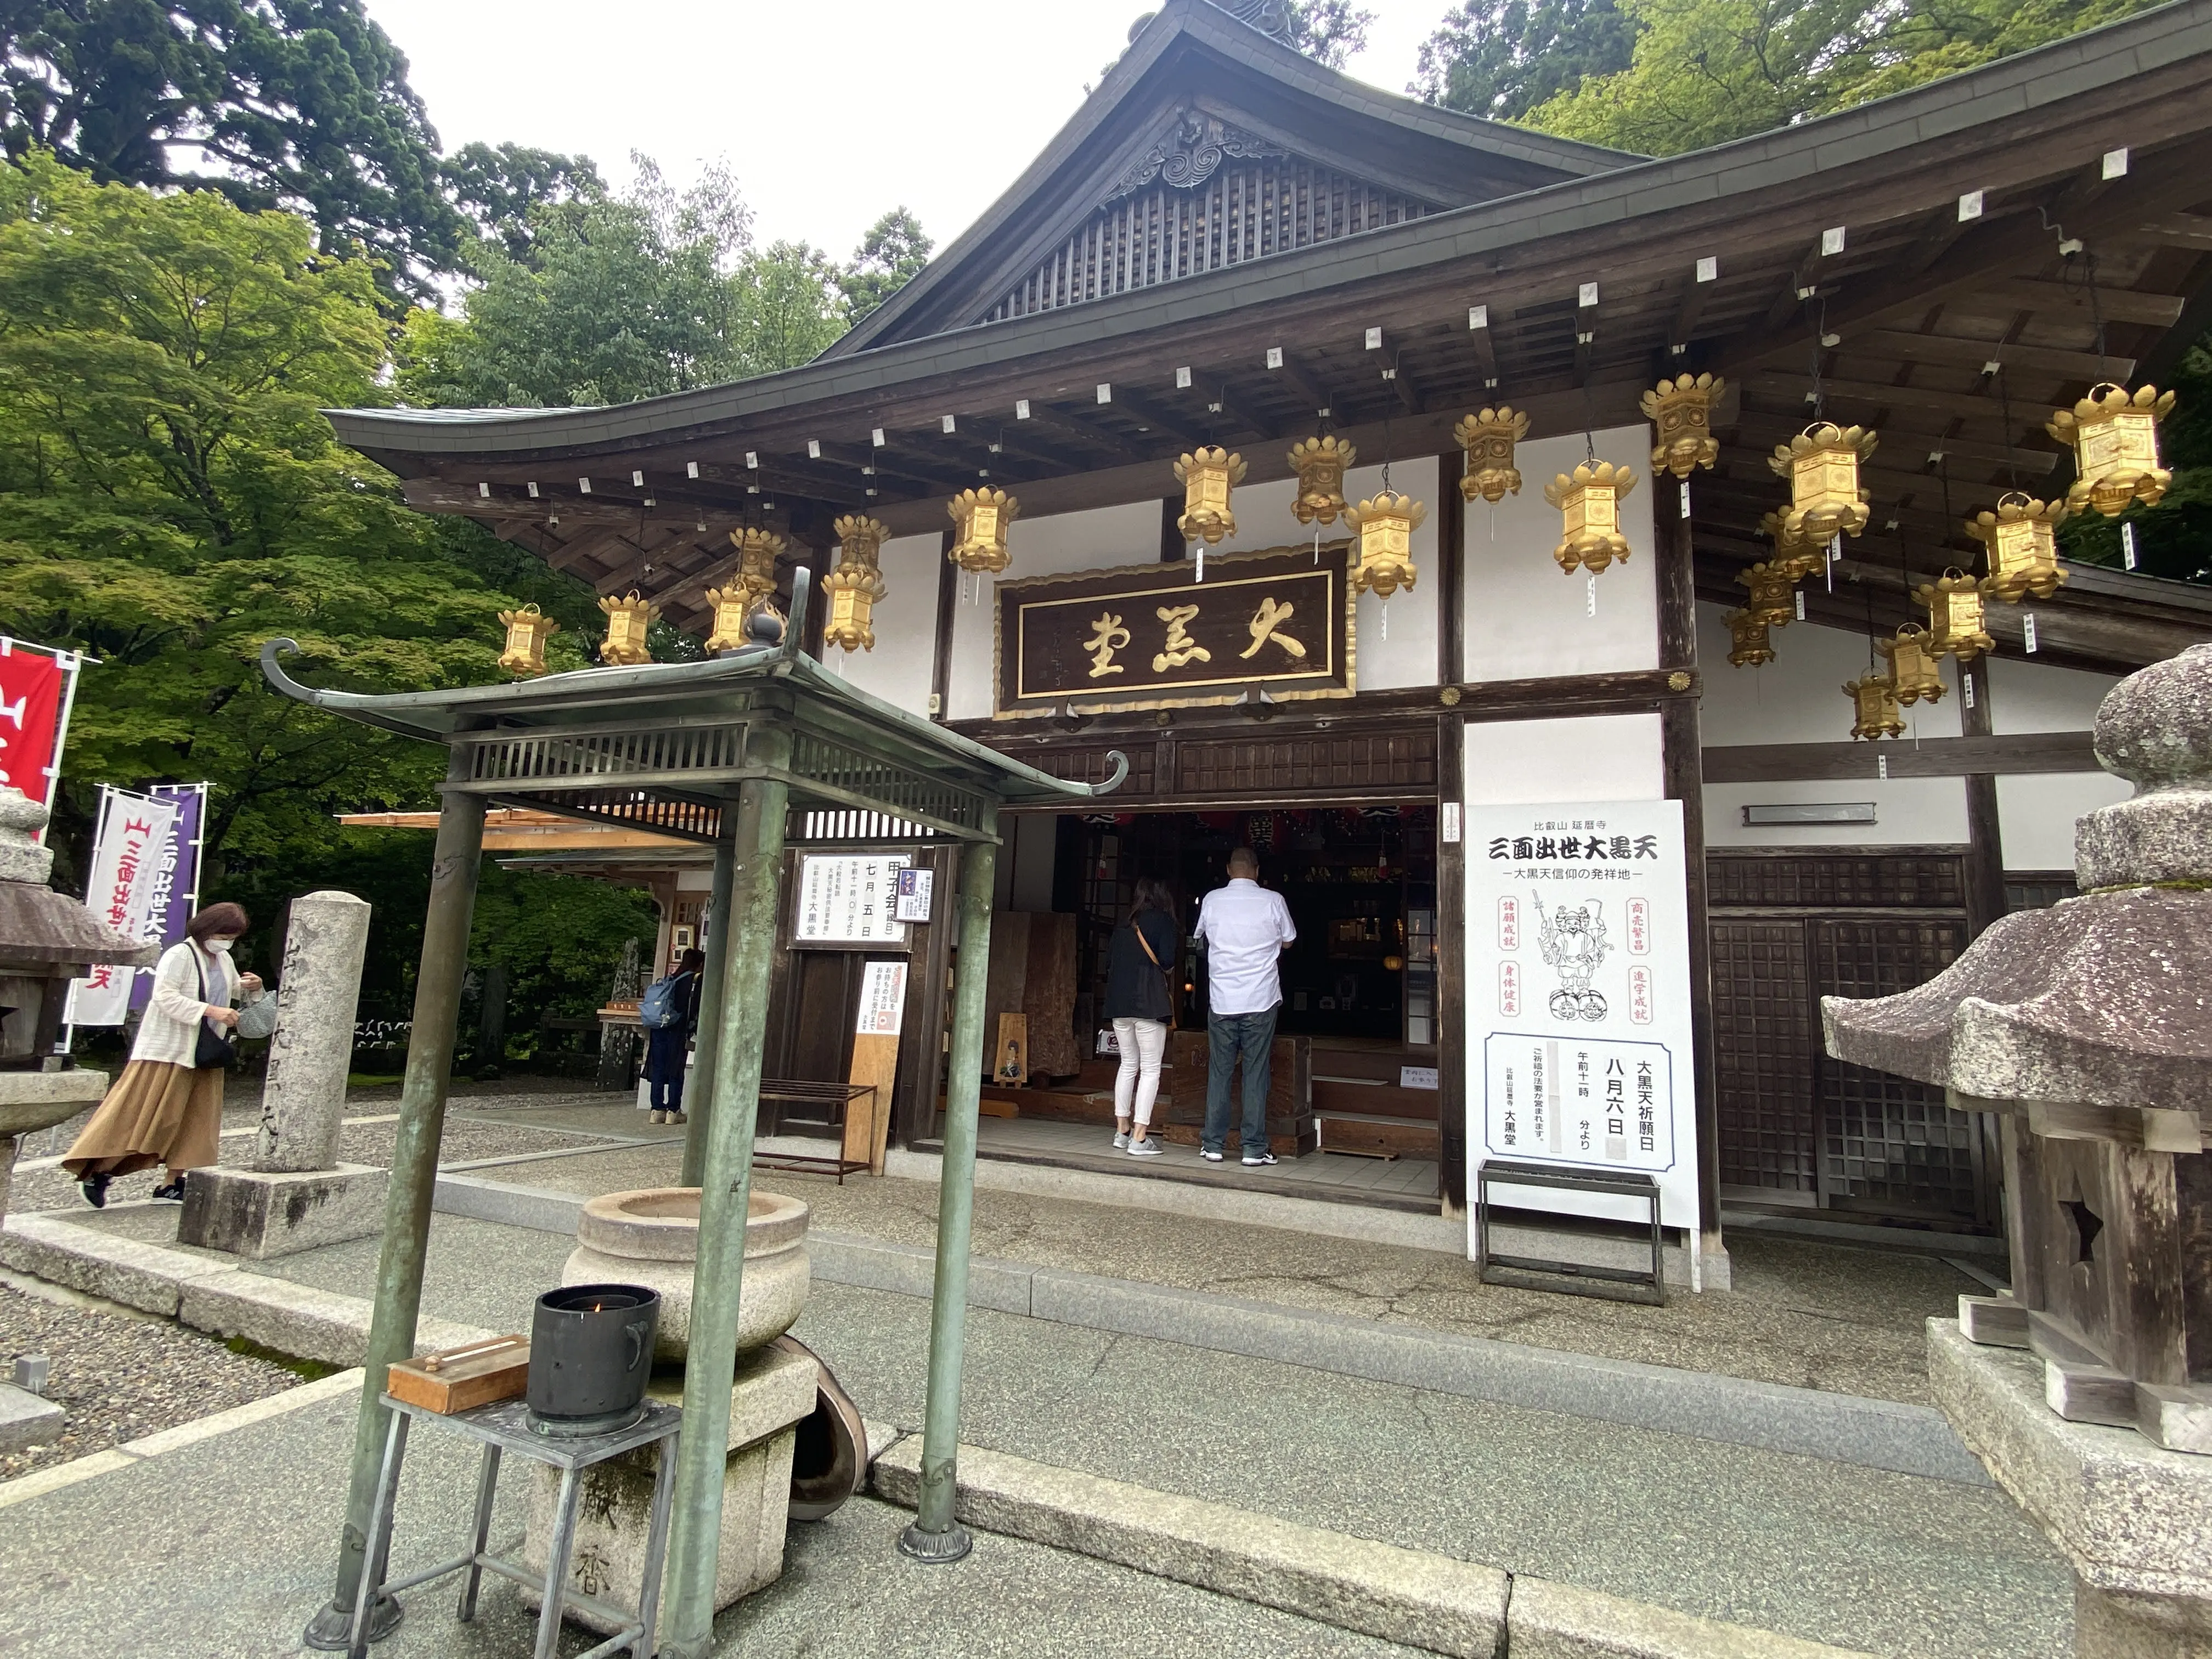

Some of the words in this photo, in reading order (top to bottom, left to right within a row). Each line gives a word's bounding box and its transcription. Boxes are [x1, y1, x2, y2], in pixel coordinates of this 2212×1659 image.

[1488, 834, 1658, 860] 三面出世大黒天
[862, 864, 876, 936] 七月五日
[1503, 902, 1516, 946] 諸願成就
[1503, 966, 1516, 1012] 身体健康
[1633, 970, 1647, 1021] 進学成就
[1577, 1051, 1589, 1098] 午前十一時
[1606, 1058, 1624, 1136] 八月六日
[1637, 1060, 1654, 1152] 大黒天祈願日
[1579, 1120, 1590, 1150] 分より
